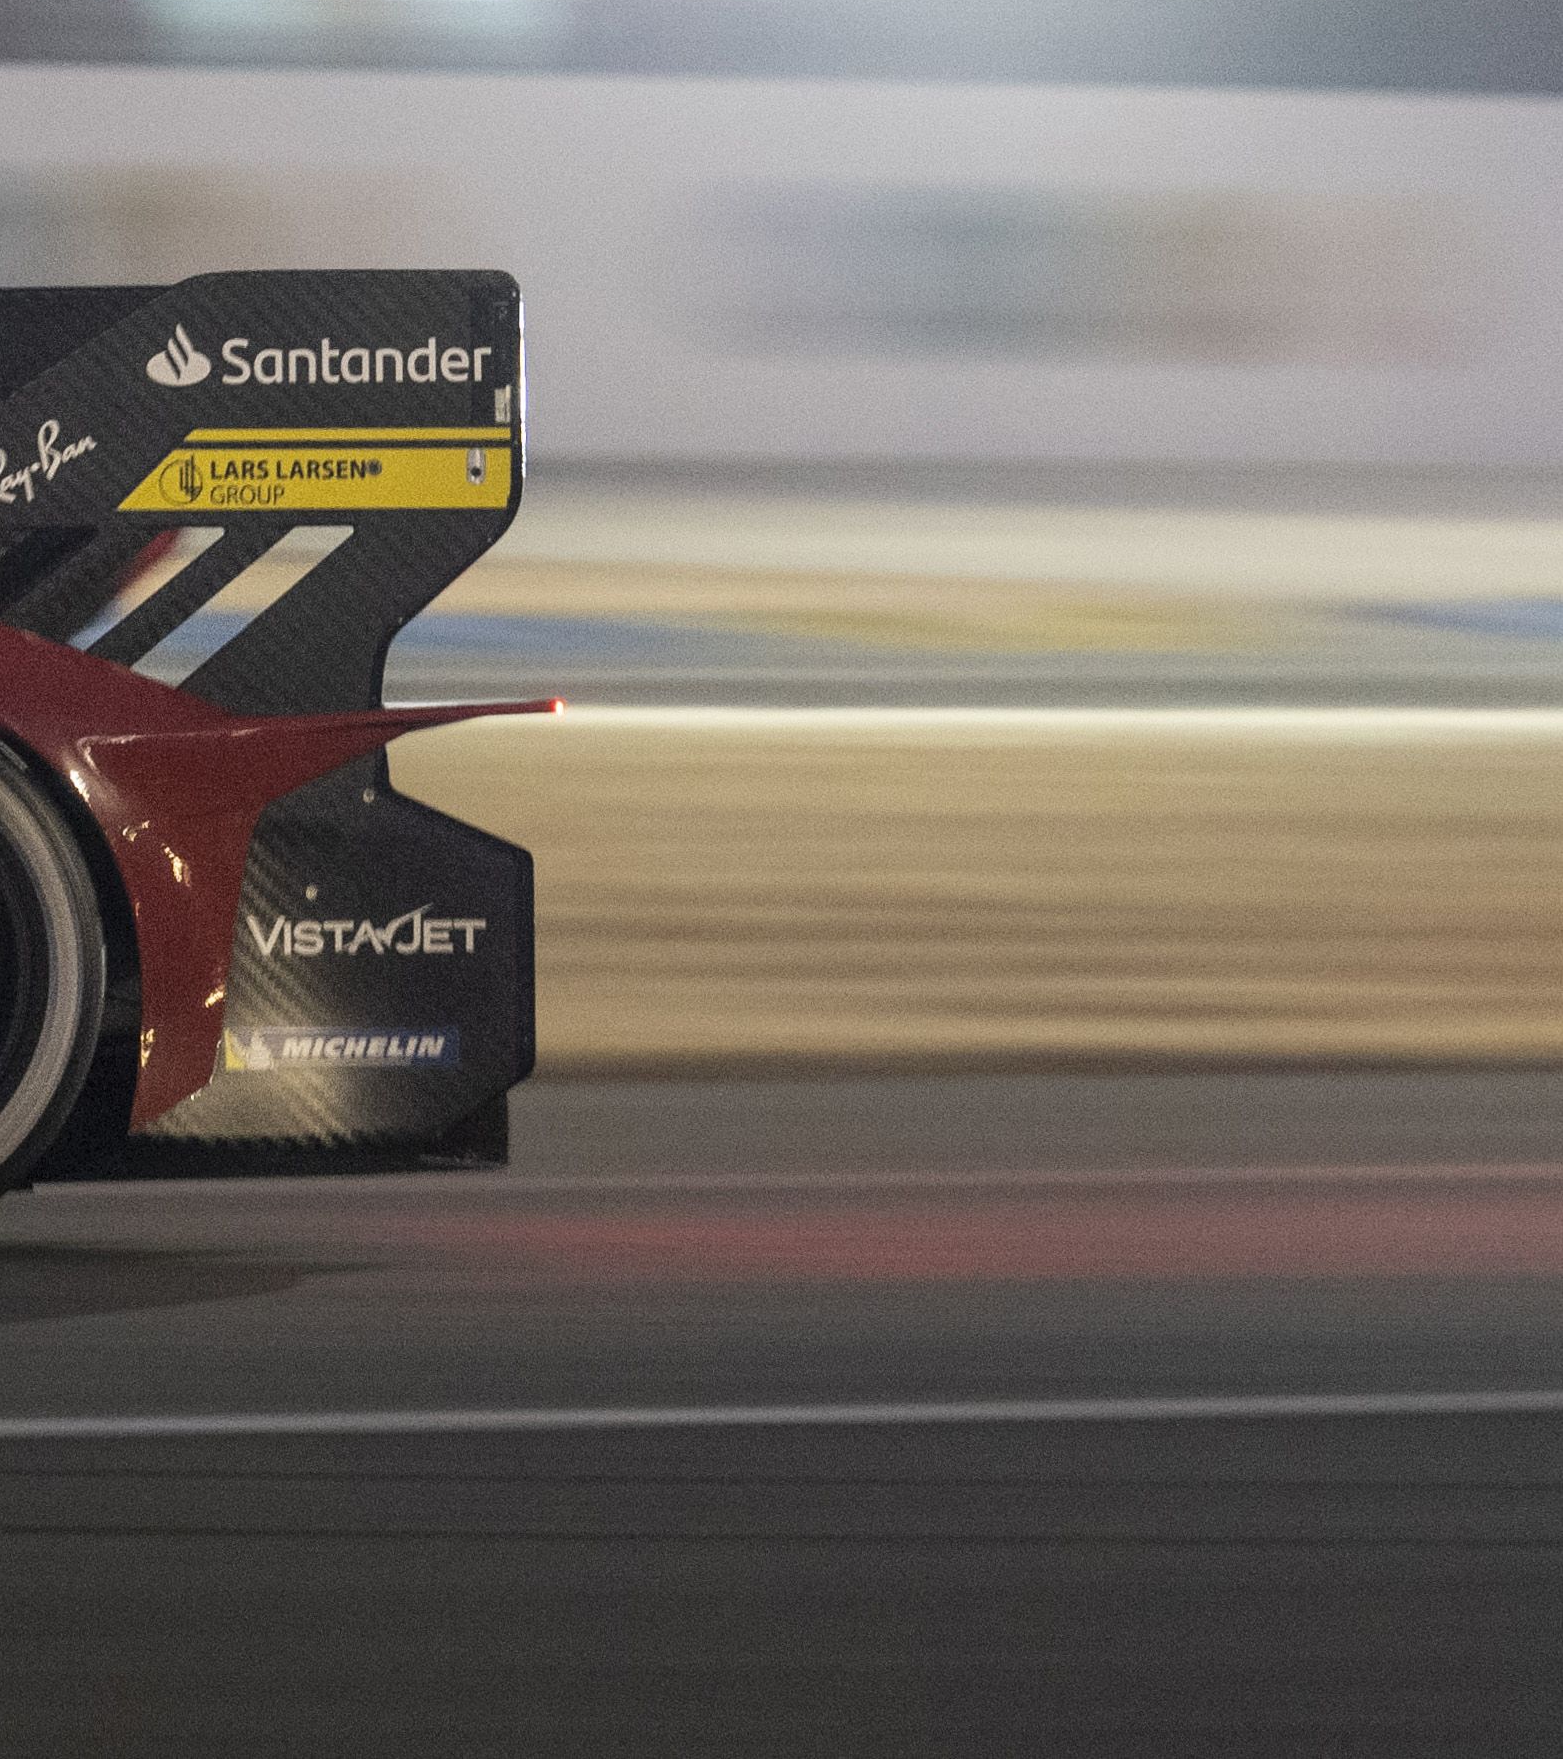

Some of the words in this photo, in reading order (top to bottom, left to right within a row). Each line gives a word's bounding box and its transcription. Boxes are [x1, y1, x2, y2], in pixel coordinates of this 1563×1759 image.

[221, 336, 492, 385] Santander
[211, 459, 270, 480] LARS
[210, 484, 286, 506] GROUP
[281, 1035, 446, 1060] MICHELIN
